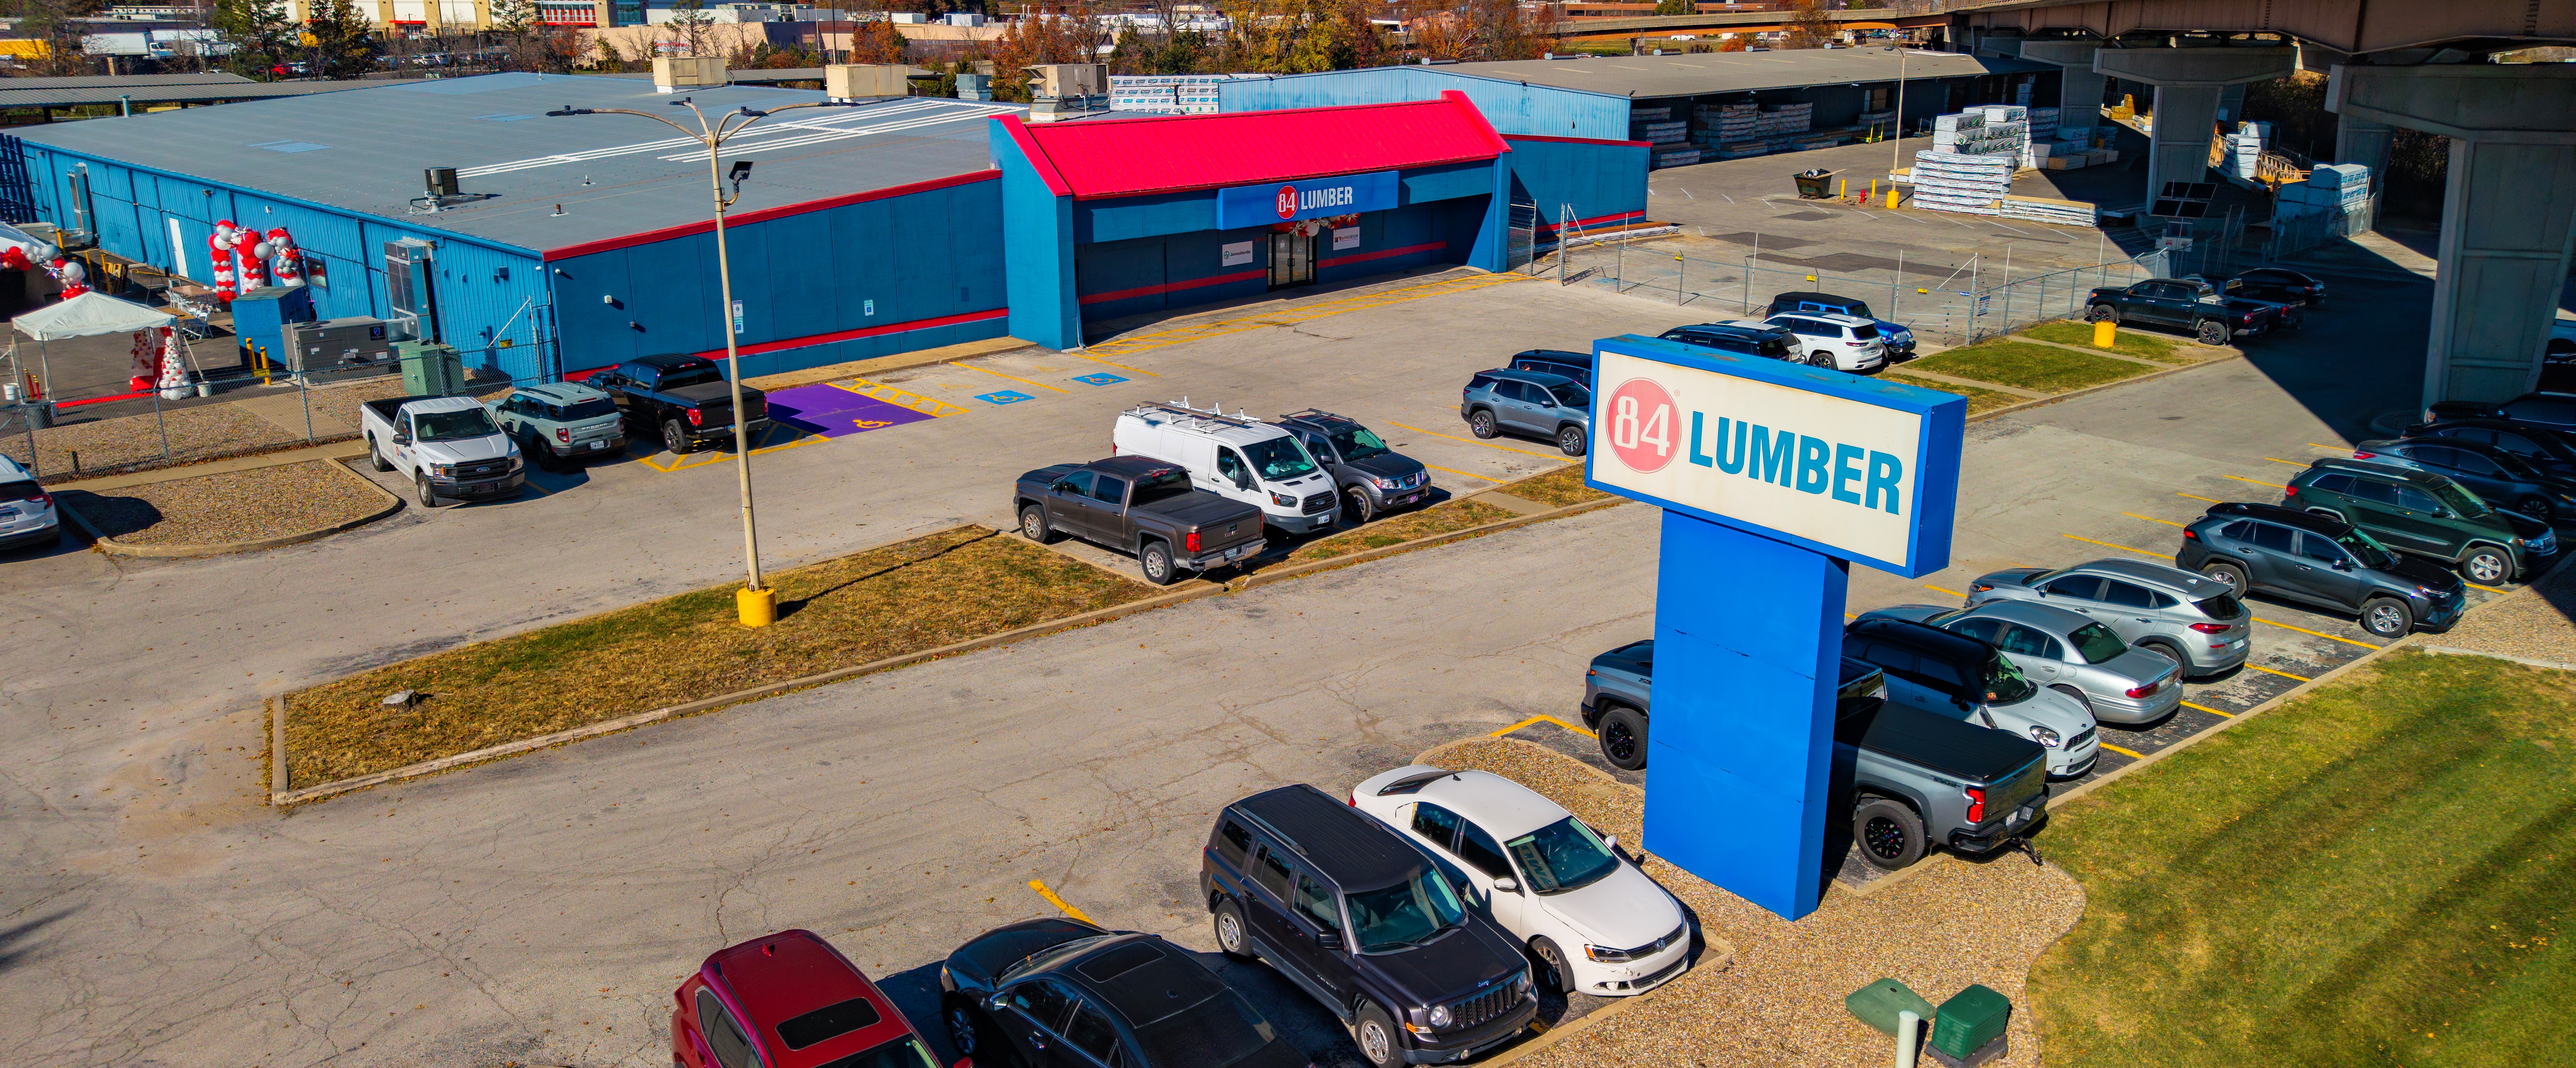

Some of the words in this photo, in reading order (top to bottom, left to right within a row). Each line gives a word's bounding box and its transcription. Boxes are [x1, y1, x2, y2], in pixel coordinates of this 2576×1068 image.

[1279, 192, 1295, 212] 84
[1301, 186, 1352, 210] LUMBER
[1614, 396, 1670, 457] 84
[1690, 411, 1902, 515] LUMBER
